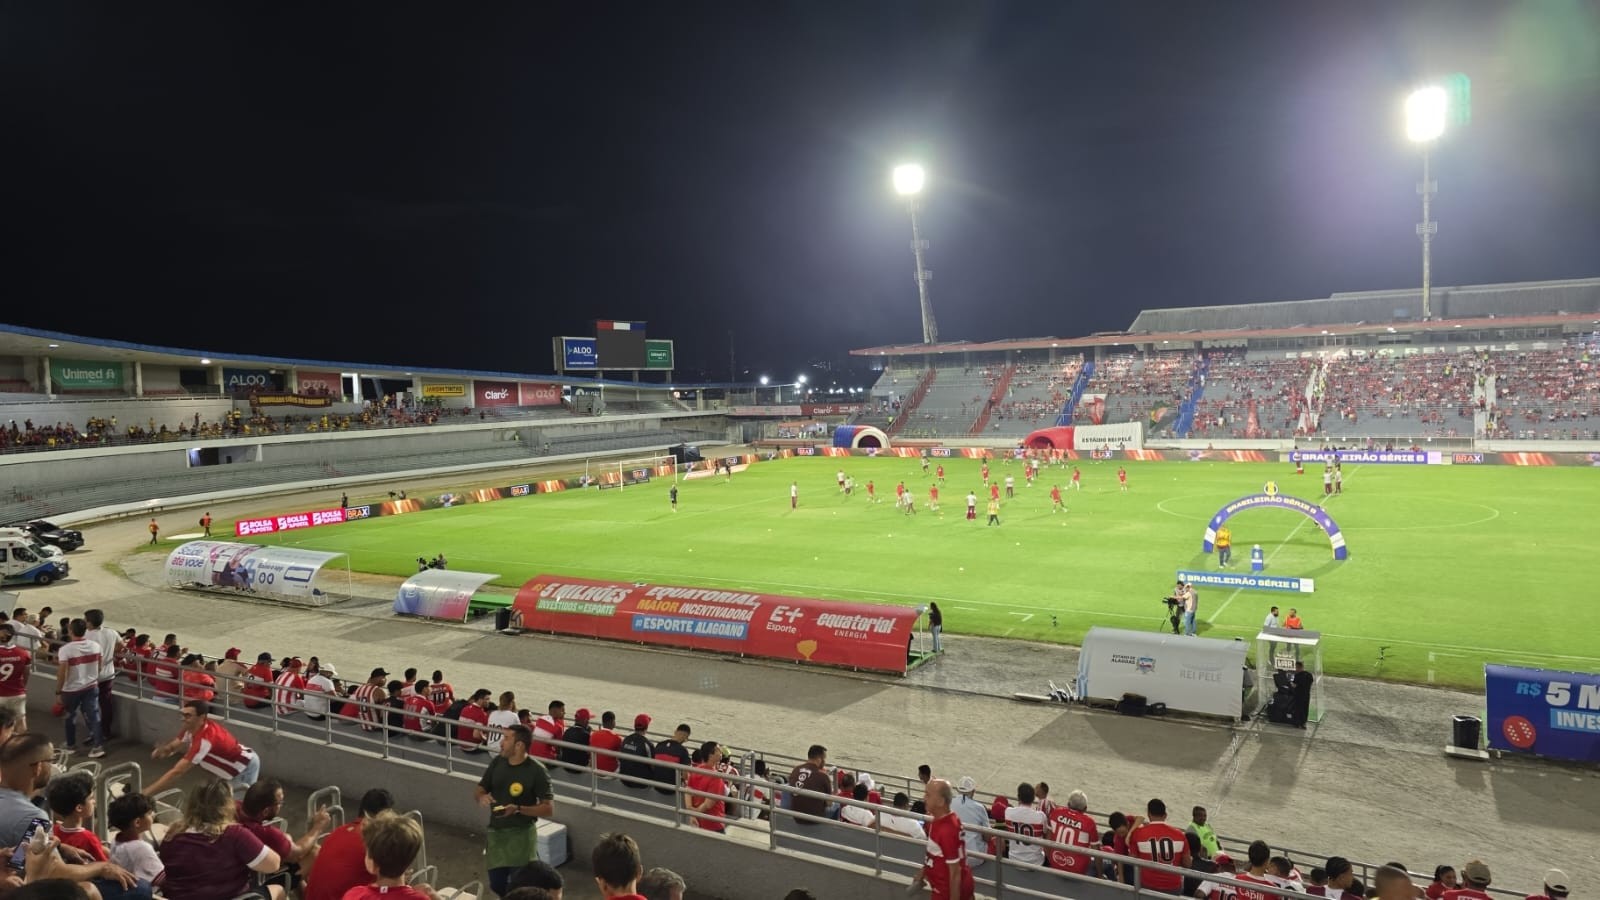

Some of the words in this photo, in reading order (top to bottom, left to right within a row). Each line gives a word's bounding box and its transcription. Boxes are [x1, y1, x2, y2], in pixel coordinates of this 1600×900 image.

[62, 368, 102, 379] Unimed
[485, 390, 506, 400] Claro
[1379, 451, 1414, 462] SÉRIE
[1455, 454, 1481, 463] BRAX
[1227, 496, 1282, 513] BRASILEIRÃO
[287, 514, 309, 522] BOLSA
[347, 508, 368, 519] BRAX
[250, 520, 273, 528] BOLSA
[1187, 574, 1256, 586] BRASILEIRÃO
[1258, 579, 1290, 588] SÉRIE
[540, 583, 560, 597] 5
[552, 584, 632, 604] MILHÕES
[645, 587, 761, 610] EQUATORIAL,
[537, 599, 578, 611] INVESTIDOS
[584, 603, 615, 615] ESPORTE
[637, 599, 679, 613] MAIOR
[679, 602, 755, 621] INCENTIVADORA
[643, 617, 693, 632] ESPORTE
[694, 622, 745, 637] ALAGOANO
[766, 622, 797, 634] Esporte
[816, 612, 897, 634] equatorial
[834, 629, 868, 640] ENERGIA
[1180, 670, 1195, 680] REI
[1516, 682, 1542, 698] R$
[1545, 681, 1571, 707] 5
[1057, 814, 1082, 829] CAIXA
[1013, 822, 1035, 845] 10
[1056, 826, 1075, 845] 10
[1149, 837, 1175, 862] 10
